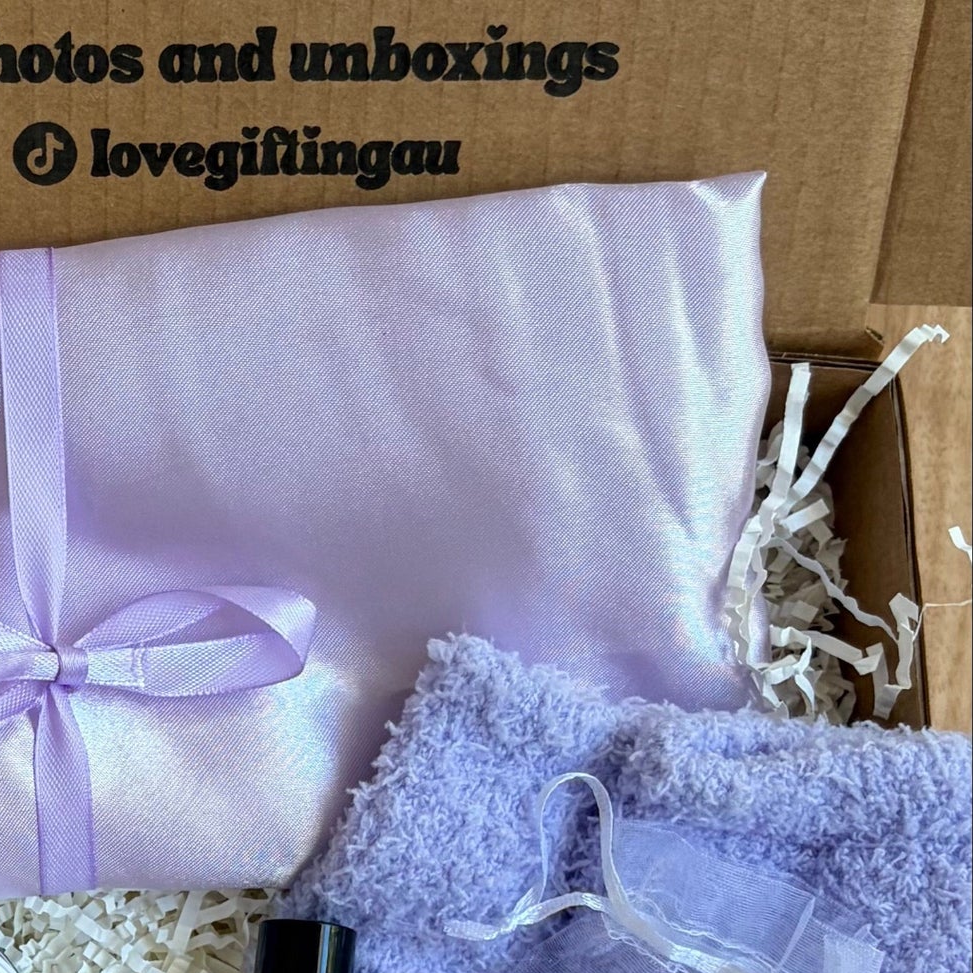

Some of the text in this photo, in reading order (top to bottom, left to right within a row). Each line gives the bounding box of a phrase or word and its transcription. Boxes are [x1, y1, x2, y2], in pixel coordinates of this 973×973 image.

[158, 26, 278, 83] and
[289, 24, 620, 97] unboxings
[91, 126, 462, 191] lovegiftingau
